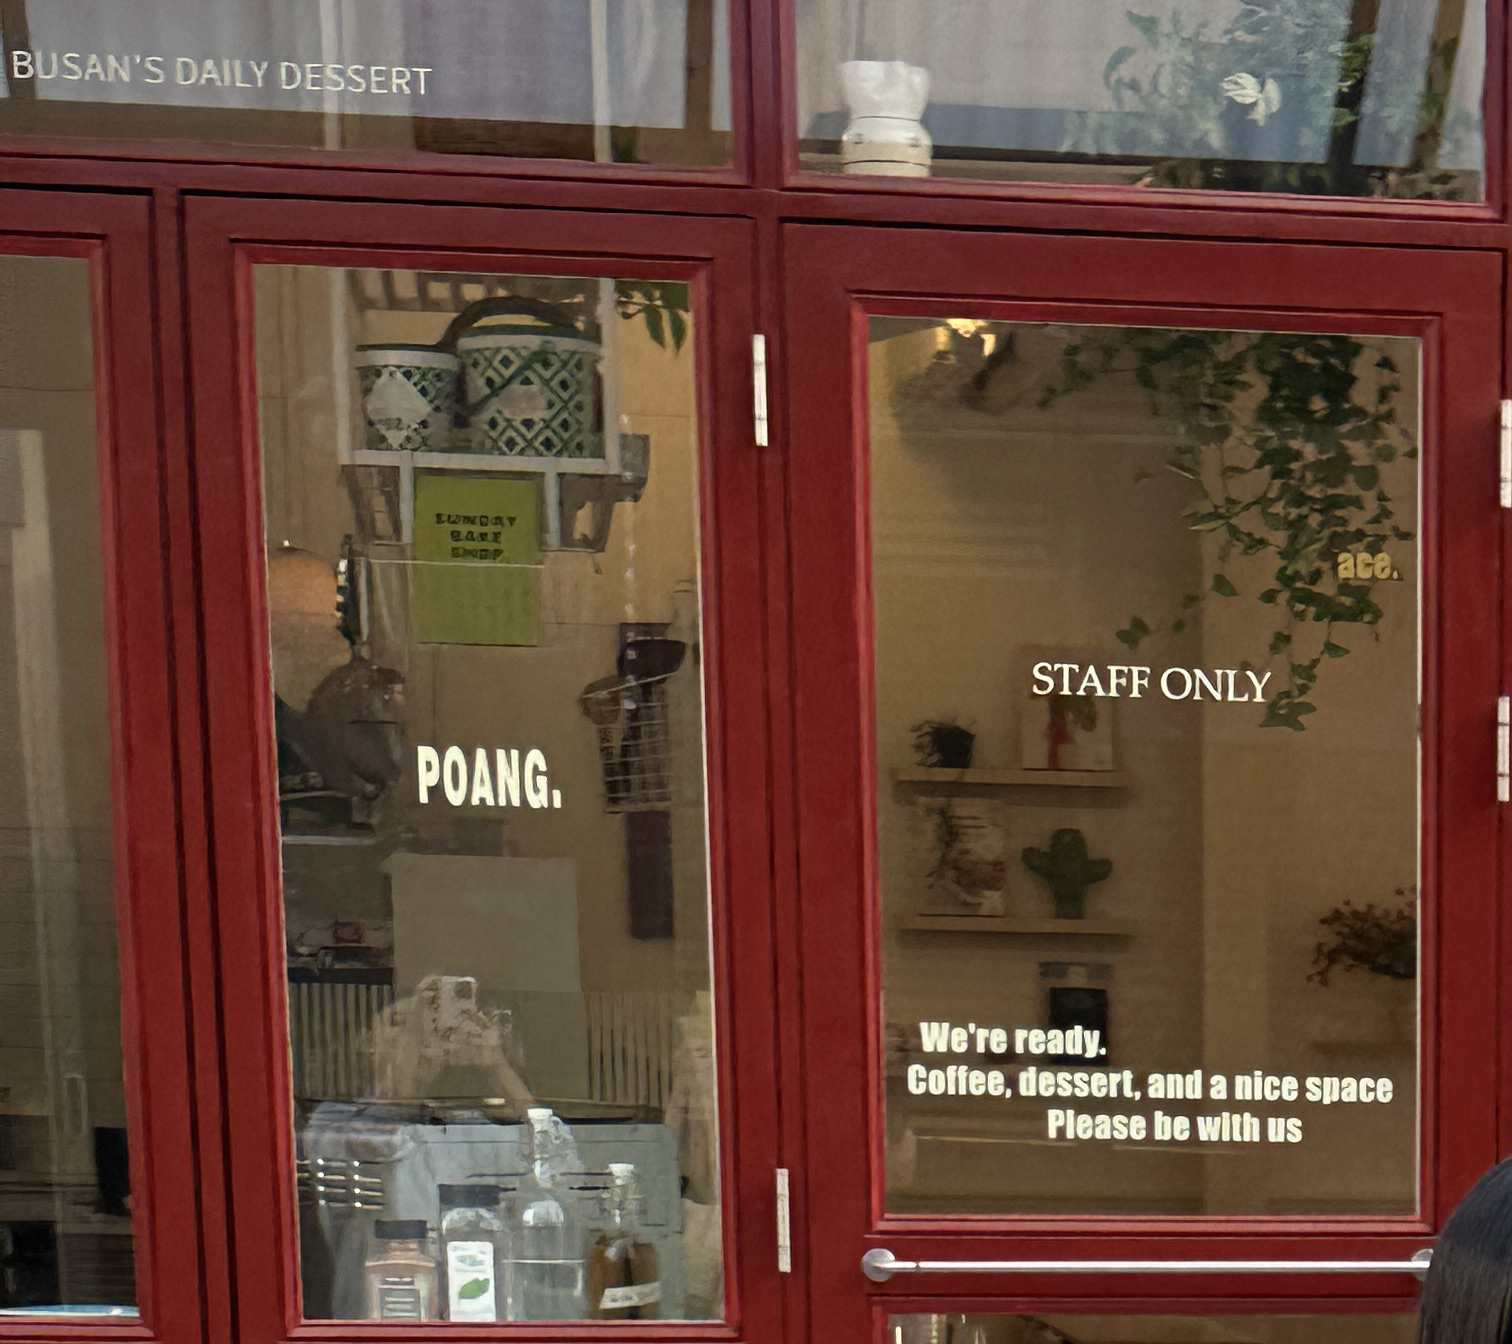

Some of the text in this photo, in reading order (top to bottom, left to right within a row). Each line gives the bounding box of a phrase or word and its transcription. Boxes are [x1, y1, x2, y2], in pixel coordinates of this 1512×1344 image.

[11, 49, 433, 96] BUSAN'S DAILY DESSERT
[1032, 661, 1272, 702] STAFF ONLY
[417, 745, 562, 809] POANG.
[920, 1021, 1108, 1059] We're ready.
[907, 1063, 1394, 1106] Coffee, dessert, and a nice space
[1047, 1108, 1303, 1143] Please be with us
